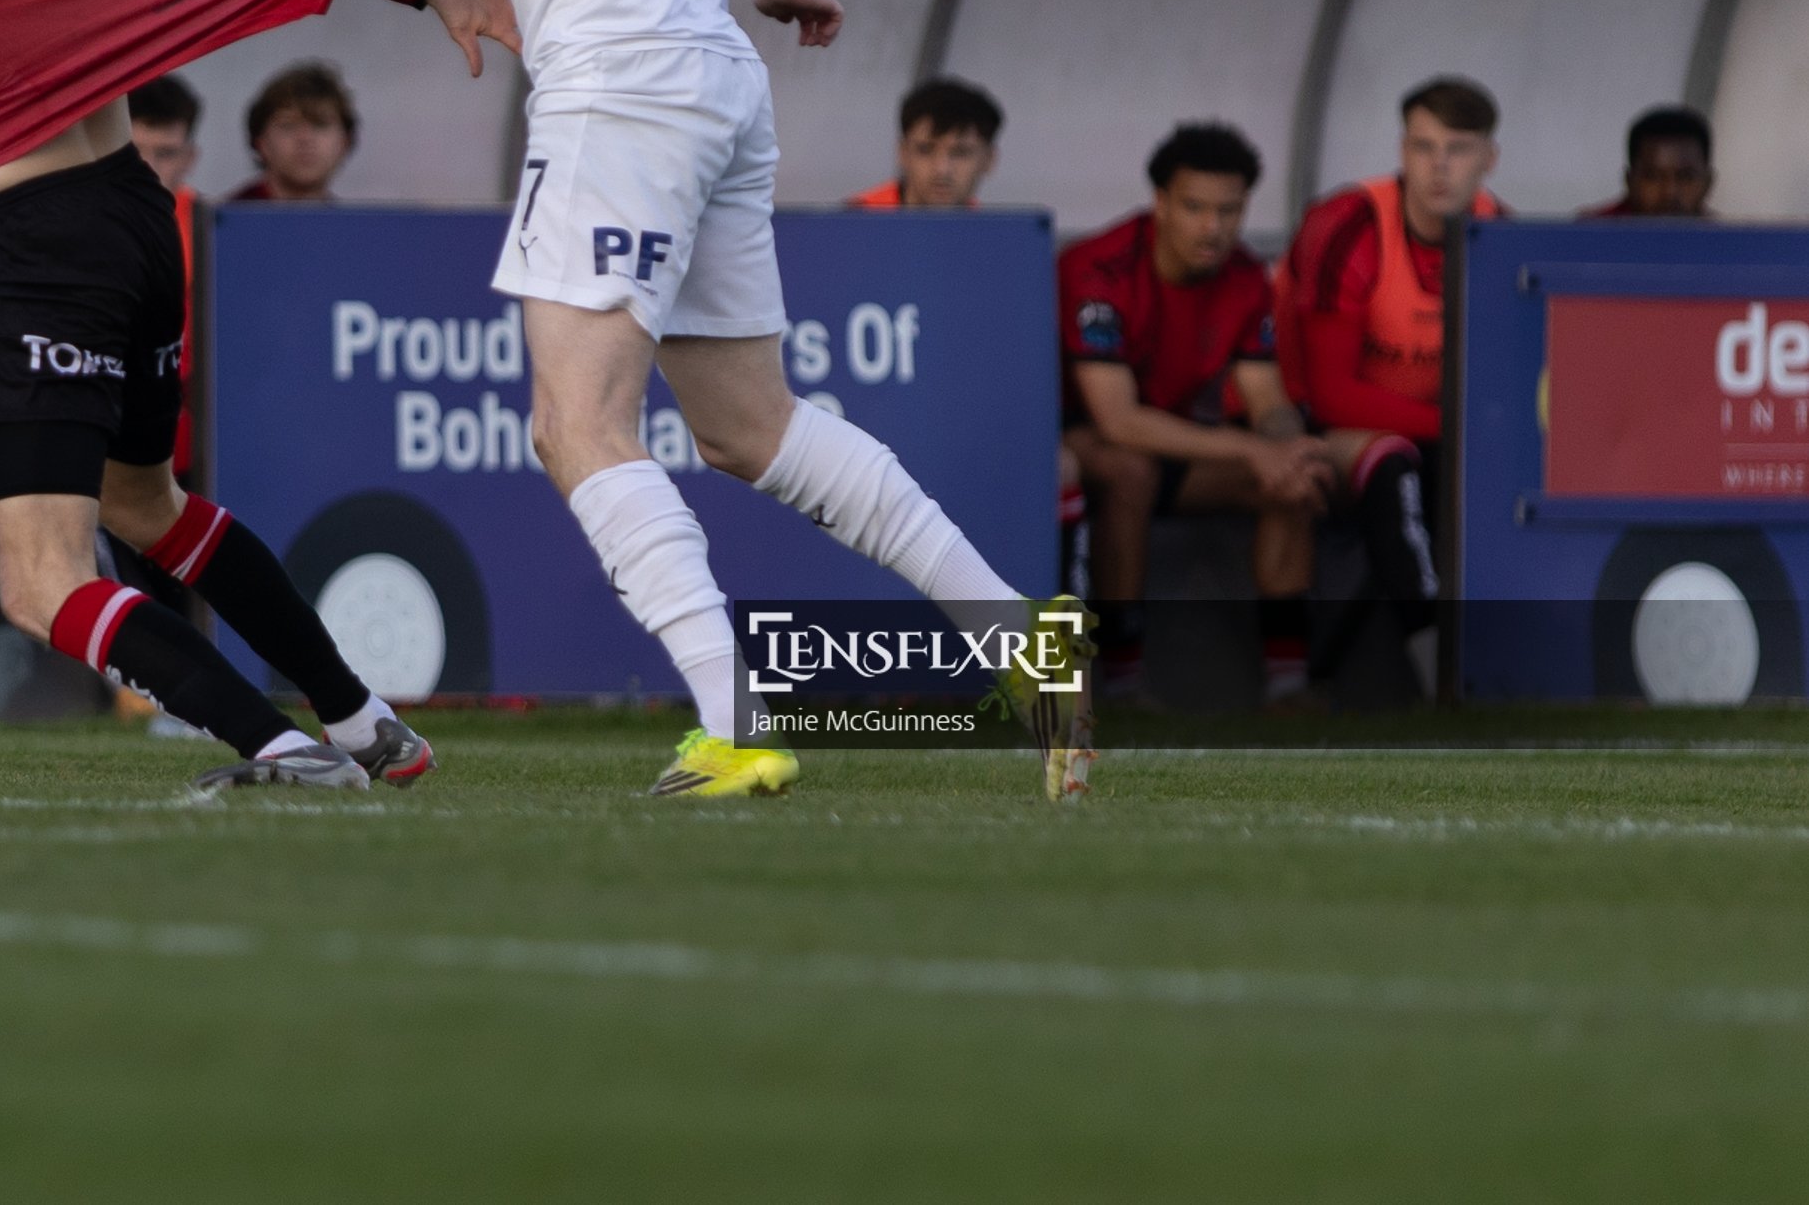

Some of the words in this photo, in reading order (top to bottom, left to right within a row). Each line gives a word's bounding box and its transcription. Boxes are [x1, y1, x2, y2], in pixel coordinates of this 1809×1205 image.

[504, 158, 550, 231] 7
[592, 225, 674, 282] PF
[333, 300, 525, 384] Proud
[845, 301, 921, 385] Of
